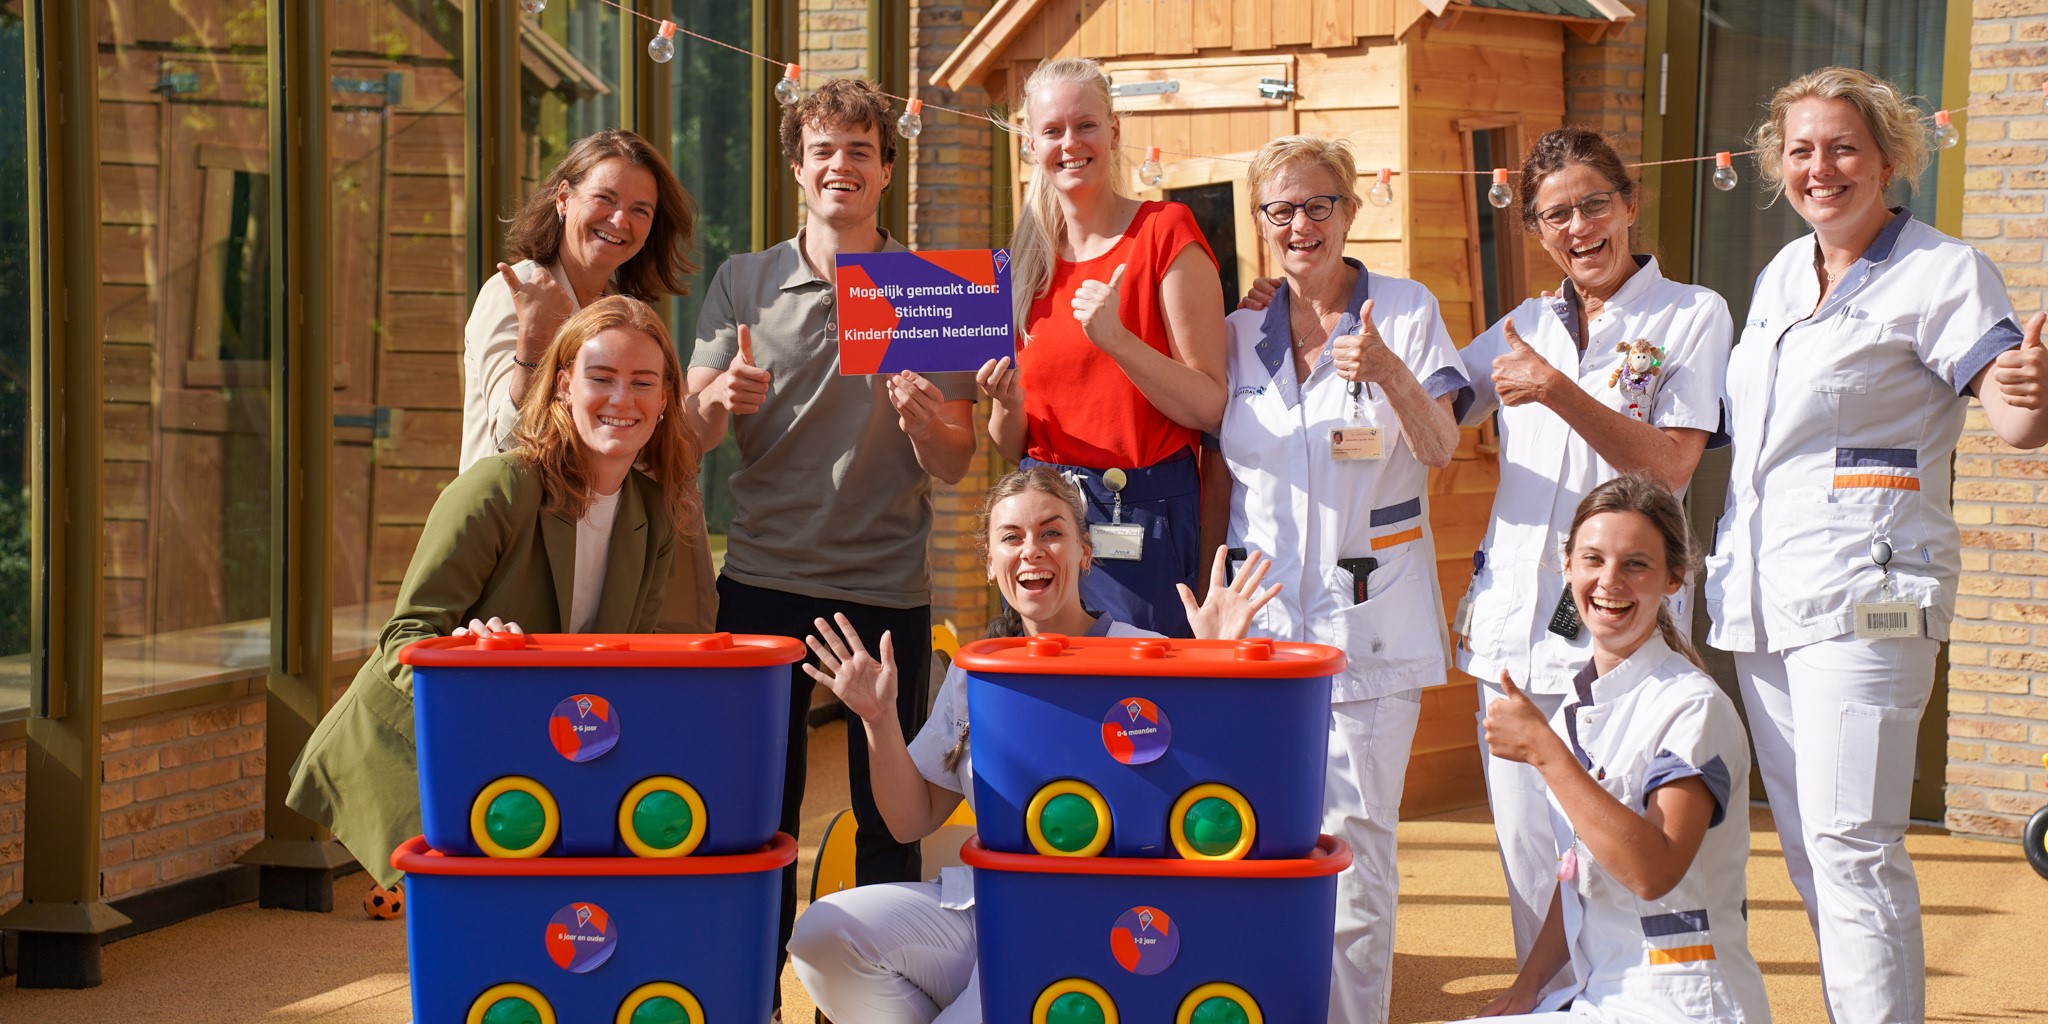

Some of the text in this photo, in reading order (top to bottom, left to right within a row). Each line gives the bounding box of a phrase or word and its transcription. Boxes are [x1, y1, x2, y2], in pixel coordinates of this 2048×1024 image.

[850, 283, 999, 300] Mogelijk gemaakt door:
[895, 305, 952, 318] Stichting
[844, 324, 1008, 340] Kinderfondsen Nederland
[1128, 727, 1157, 736] maanden
[563, 933, 577, 941] jaar
[1144, 937, 1157, 945] jaar
